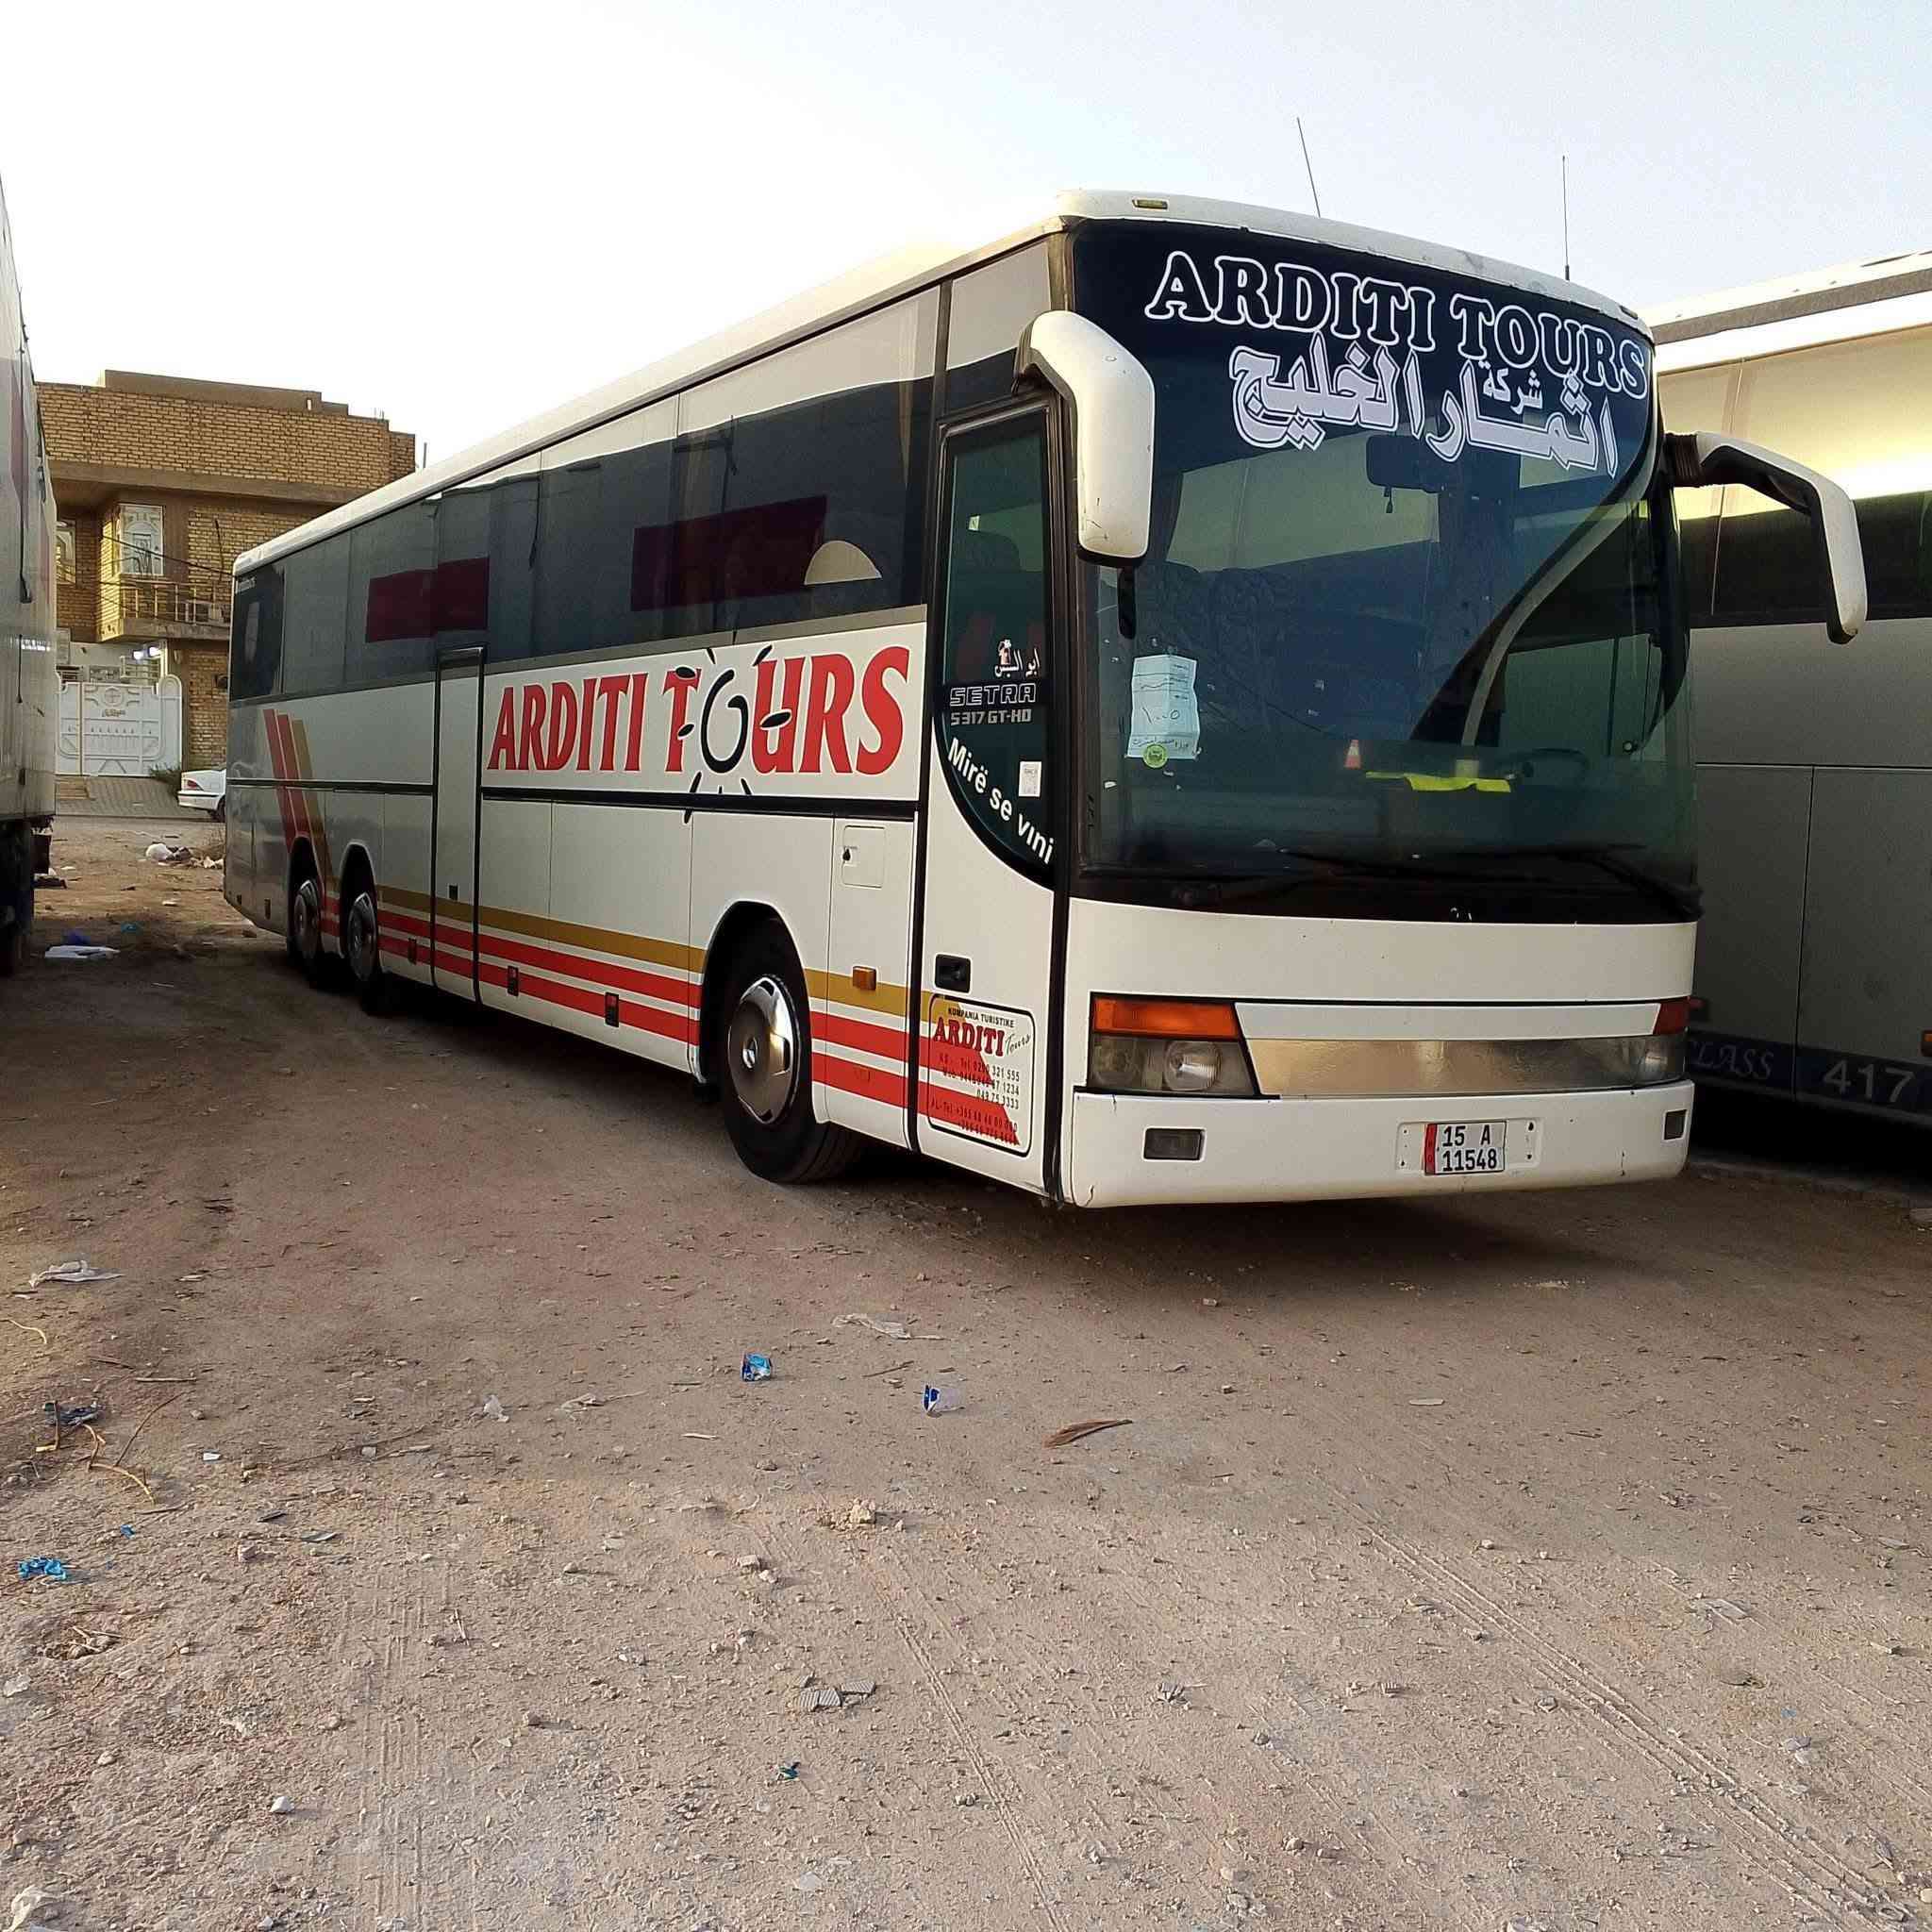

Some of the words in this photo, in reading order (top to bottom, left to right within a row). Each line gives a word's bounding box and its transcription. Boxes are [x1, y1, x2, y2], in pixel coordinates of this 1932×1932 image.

[1144, 251, 1436, 352] ARDITI
[1450, 293, 1648, 399] TOURS
[1229, 331, 1425, 451] الخليج
[1477, 360, 1543, 415] شركة
[949, 682, 1037, 707] SETRA
[487, 672, 650, 772] ARDITI
[947, 737, 989, 794] Mirë
[989, 787, 1013, 822] se
[934, 1016, 1006, 1057] ARDITI
[991, 1065, 1005, 1079] 321
[1007, 1068, 1020, 1082] 555
[1691, 1041, 1774, 1079] LASS
[1002, 1081, 1020, 1095] 1234
[1824, 1059, 1916, 1103] 417
[1442, 1124, 1466, 1147] 15
[1479, 1124, 1491, 1146] A
[1441, 1148, 1498, 1172] 11548
